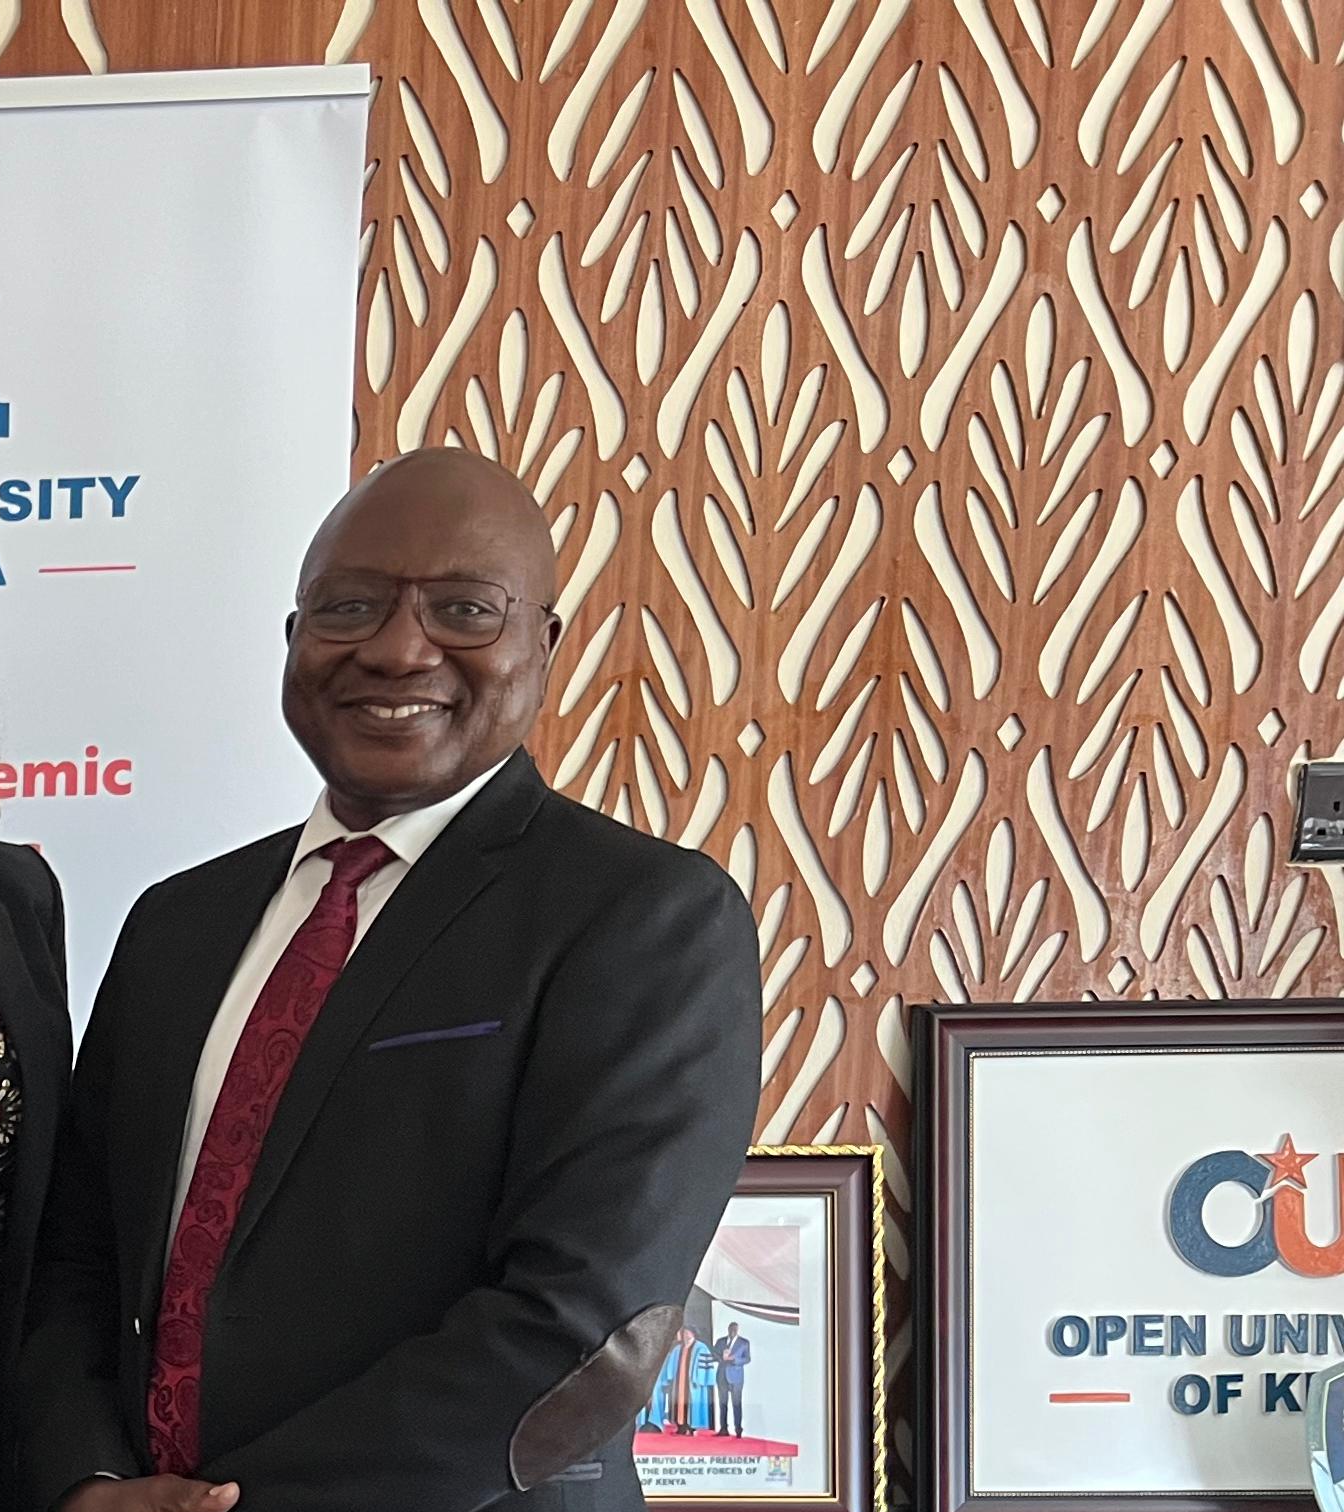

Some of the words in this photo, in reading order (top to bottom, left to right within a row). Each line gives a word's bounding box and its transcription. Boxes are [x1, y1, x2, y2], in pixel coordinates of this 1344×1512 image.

[1049, 1313, 1207, 1358] OPEN
[1172, 1373, 1244, 1416] OF
[652, 1456, 677, 1465] RUTO
[710, 1455, 762, 1465] PRESIDENT
[642, 1467, 660, 1476] THE
[662, 1467, 704, 1476] DEFENCE
[707, 1467, 743, 1476] FORCES
[745, 1467, 758, 1475] OF
[655, 1478, 687, 1486] KENYA
